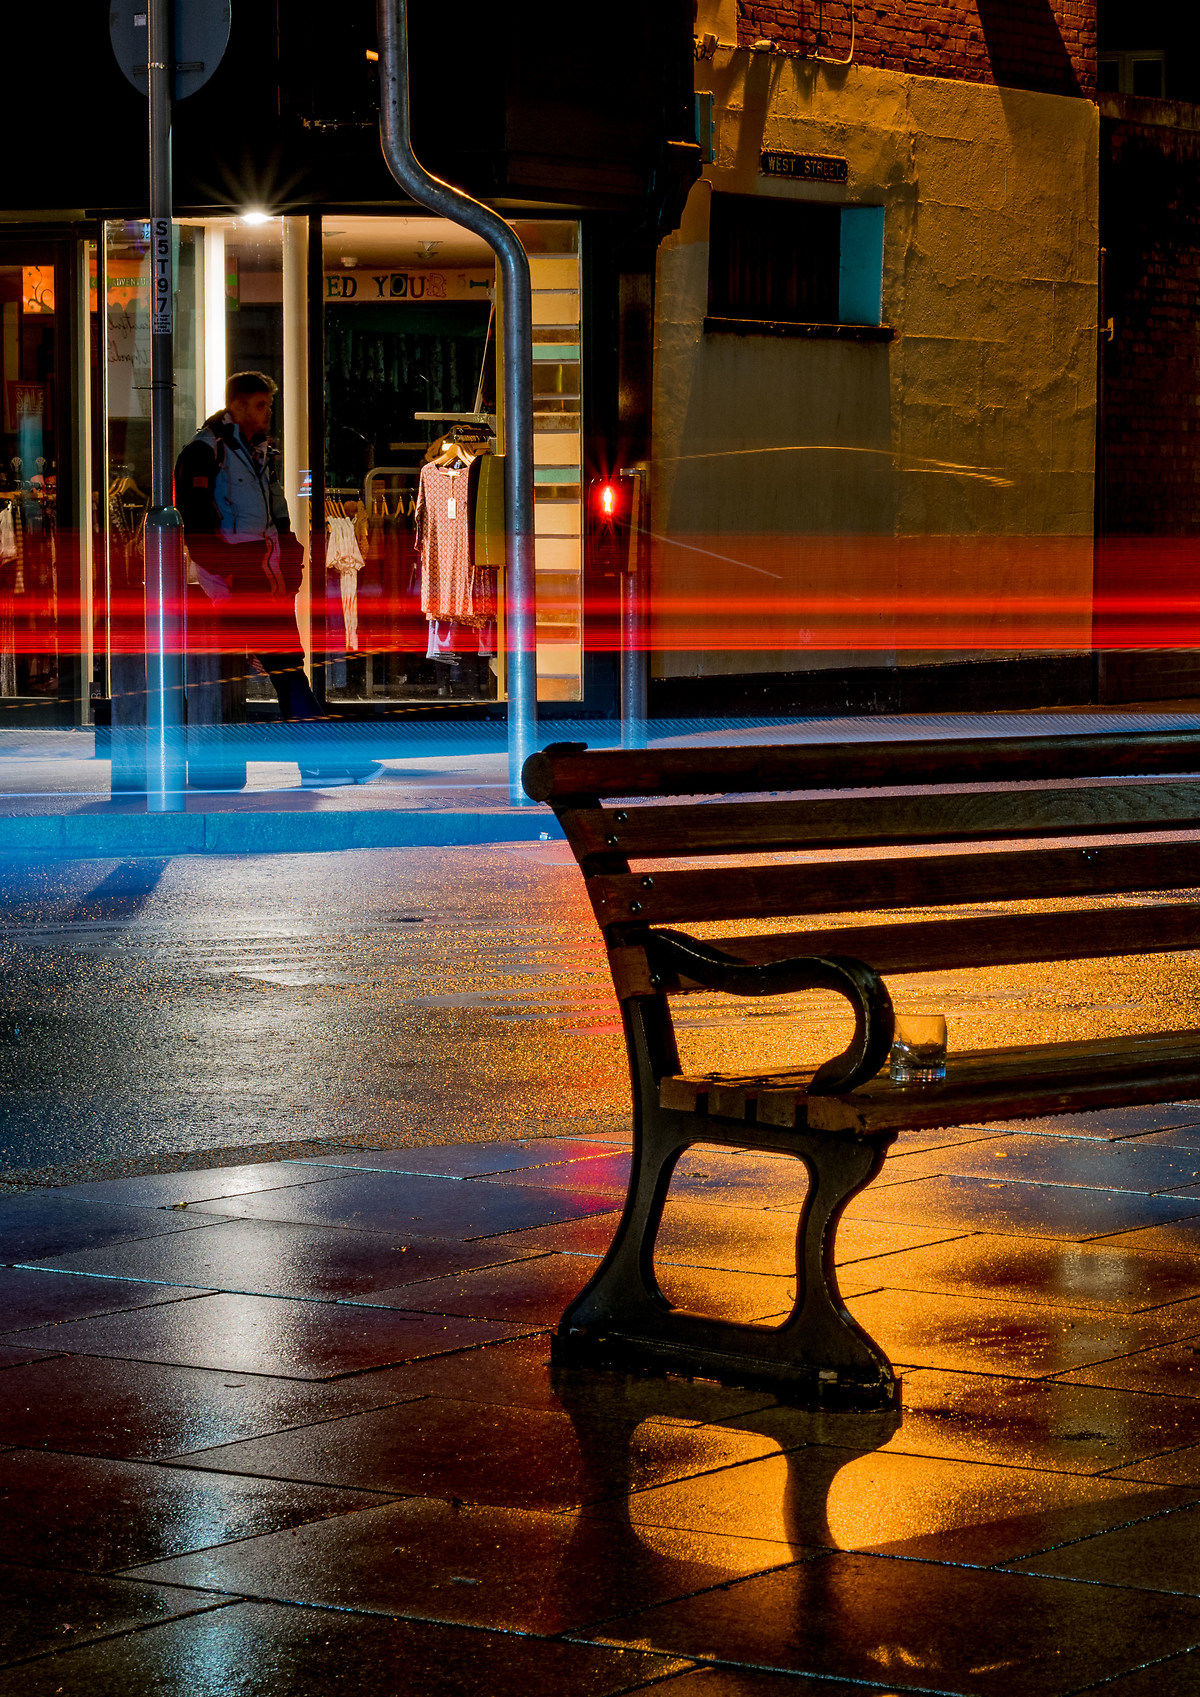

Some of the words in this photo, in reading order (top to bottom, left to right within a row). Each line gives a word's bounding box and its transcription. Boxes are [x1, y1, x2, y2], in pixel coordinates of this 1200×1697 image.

[768, 156, 796, 172] WEST
[155, 220, 169, 313] S5T97
[372, 272, 447, 298] YOUR
